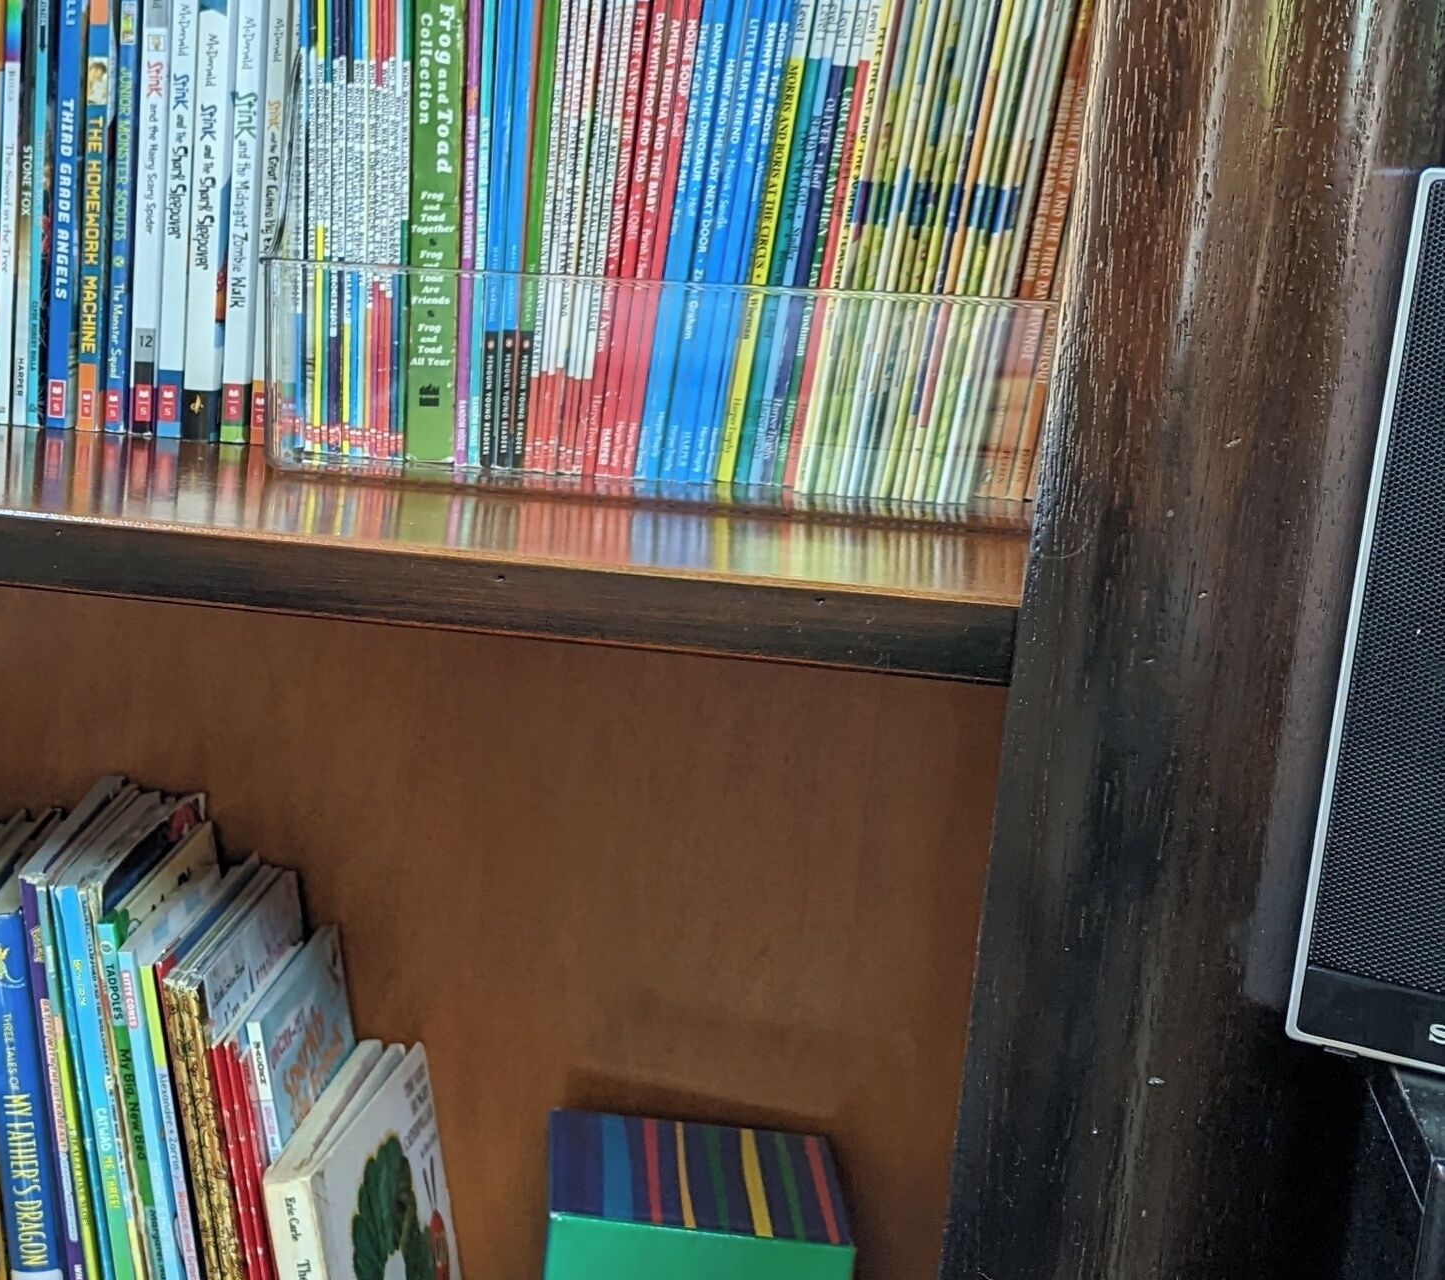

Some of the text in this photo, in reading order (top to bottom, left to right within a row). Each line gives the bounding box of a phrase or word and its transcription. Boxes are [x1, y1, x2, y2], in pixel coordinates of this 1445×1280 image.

[437, 3, 456, 65] Frog
[119, 66, 132, 116] JUNIOR
[146, 60, 163, 98] Stink
[418, 12, 434, 125] Collection
[436, 68, 451, 104] and
[635, 11, 665, 182] DAYS WITH FROG AND TOAD
[60, 97, 74, 157] THIRD
[88, 115, 104, 153] THE
[166, 3, 190, 239] McDonald Stink Shark Sleepover
[436, 108, 453, 174] Toad
[692, 121, 709, 181] DINOSAUR
[21, 144, 33, 217] STONE FOX
[116, 120, 131, 183] MONSTER
[146, 143, 158, 170] Hairy
[756, 64, 800, 269] MORRIS BORIS CIRCUS
[58, 162, 72, 223] GRADE
[84, 160, 102, 265] HOMEWORK
[115, 189, 128, 240] SCOUTS
[145, 173, 157, 200] Scary
[192, 103, 217, 271] Stink Shark Sleepover
[229, 91, 258, 308] Stink Midnight Zombie Walk
[144, 203, 156, 235] Spider
[411, 224, 455, 234] Together
[55, 228, 69, 300] ANGELS
[114, 283, 124, 301] The
[80, 275, 98, 354] MACHINE
[111, 303, 123, 345] Monster
[412, 295, 450, 305] Friends
[108, 347, 122, 379] Squad
[105, 963, 148, 1161] TADPOLES My Big, New Bed
[95, 1107, 112, 1151] CATWAD
[159, 1073, 182, 1171] Alexander Zarrin
[3, 1093, 48, 1266] MY FATHER'S DRAGON
[285, 1196, 297, 1216] Eric
[288, 1217, 302, 1242] Carle
